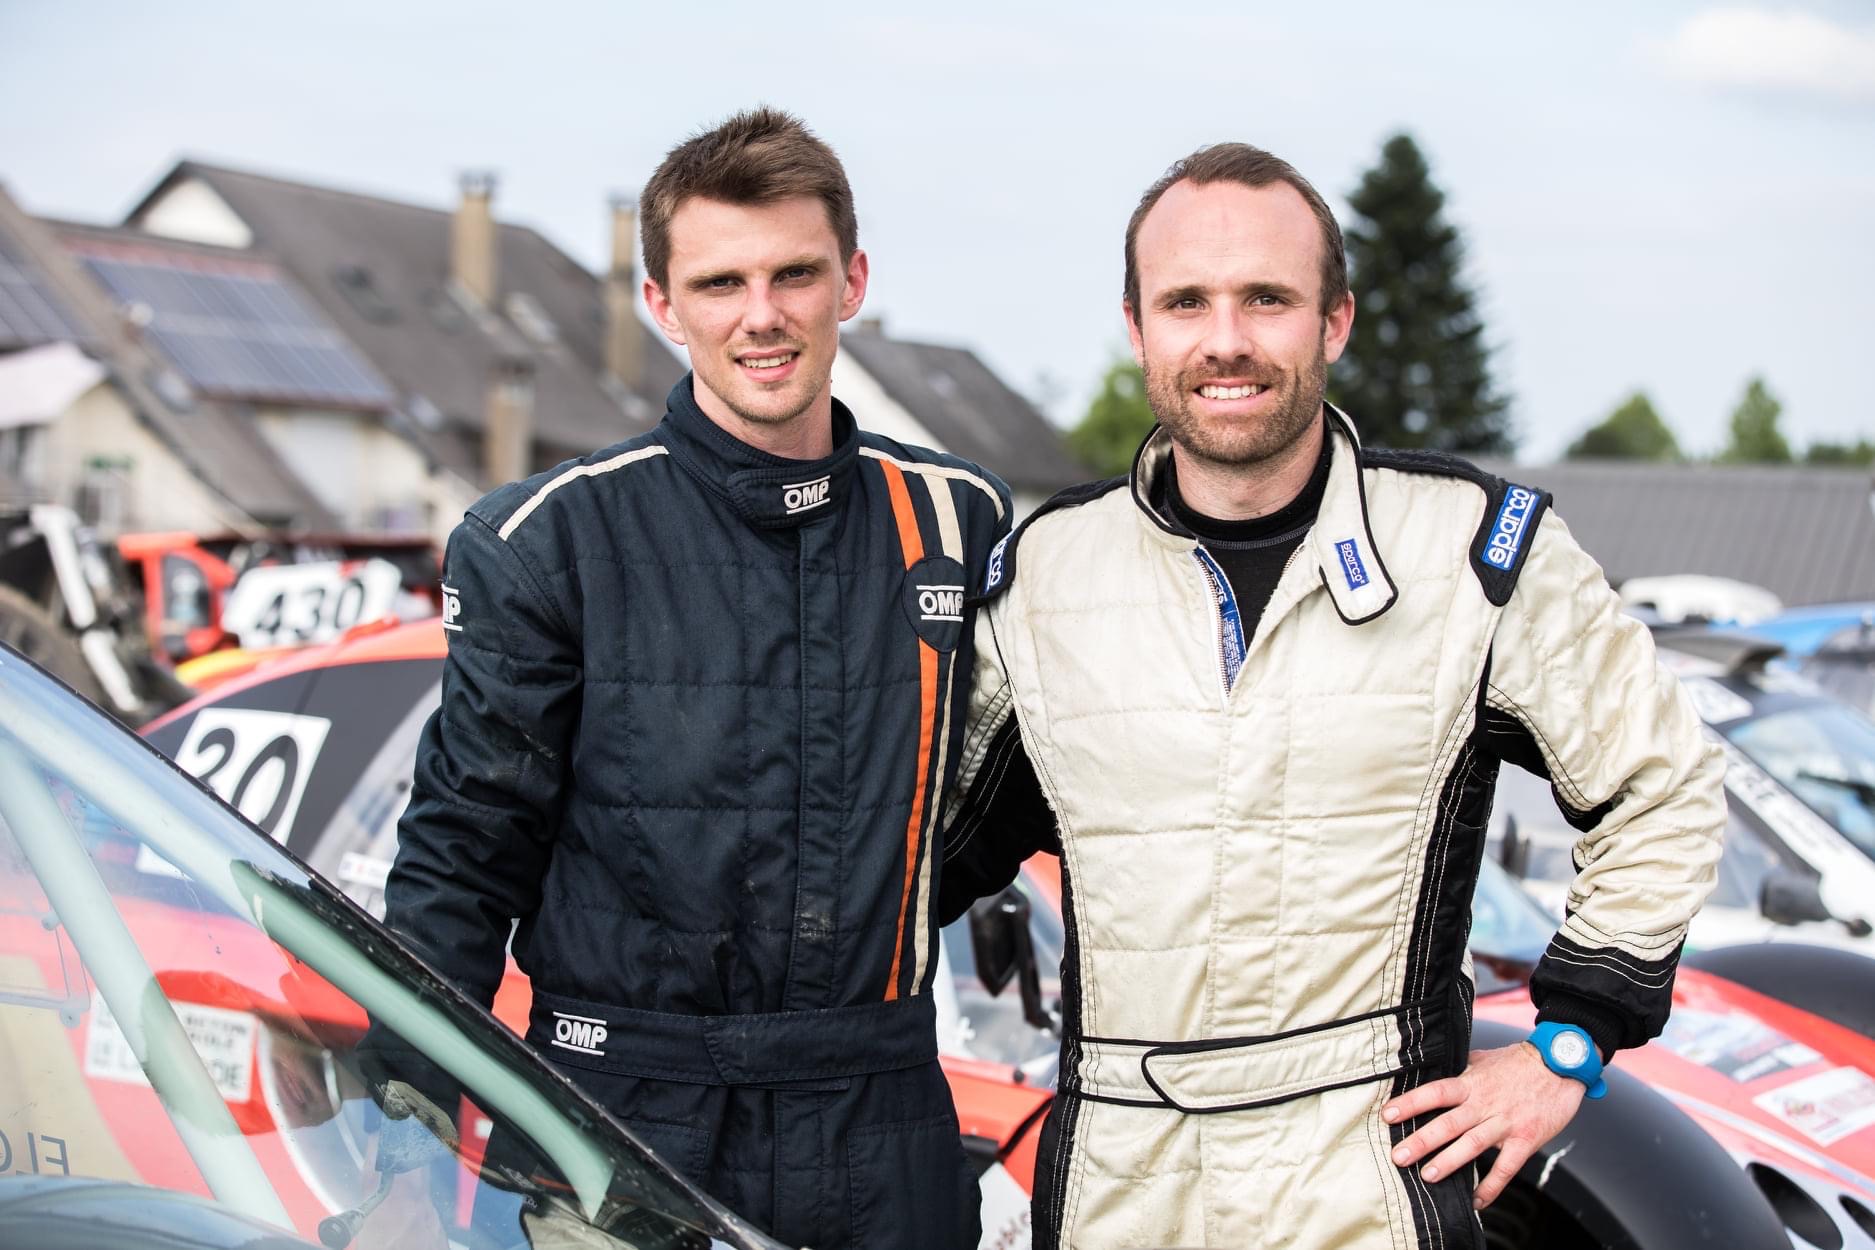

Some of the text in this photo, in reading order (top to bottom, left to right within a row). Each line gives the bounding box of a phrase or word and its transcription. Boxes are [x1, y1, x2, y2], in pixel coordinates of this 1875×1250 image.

[784, 480, 829, 509] OMP
[1488, 488, 1530, 565] sparco
[255, 577, 365, 641] 430
[918, 591, 964, 616] OMP
[197, 727, 299, 835] 20
[556, 1019, 608, 1049] OMP
